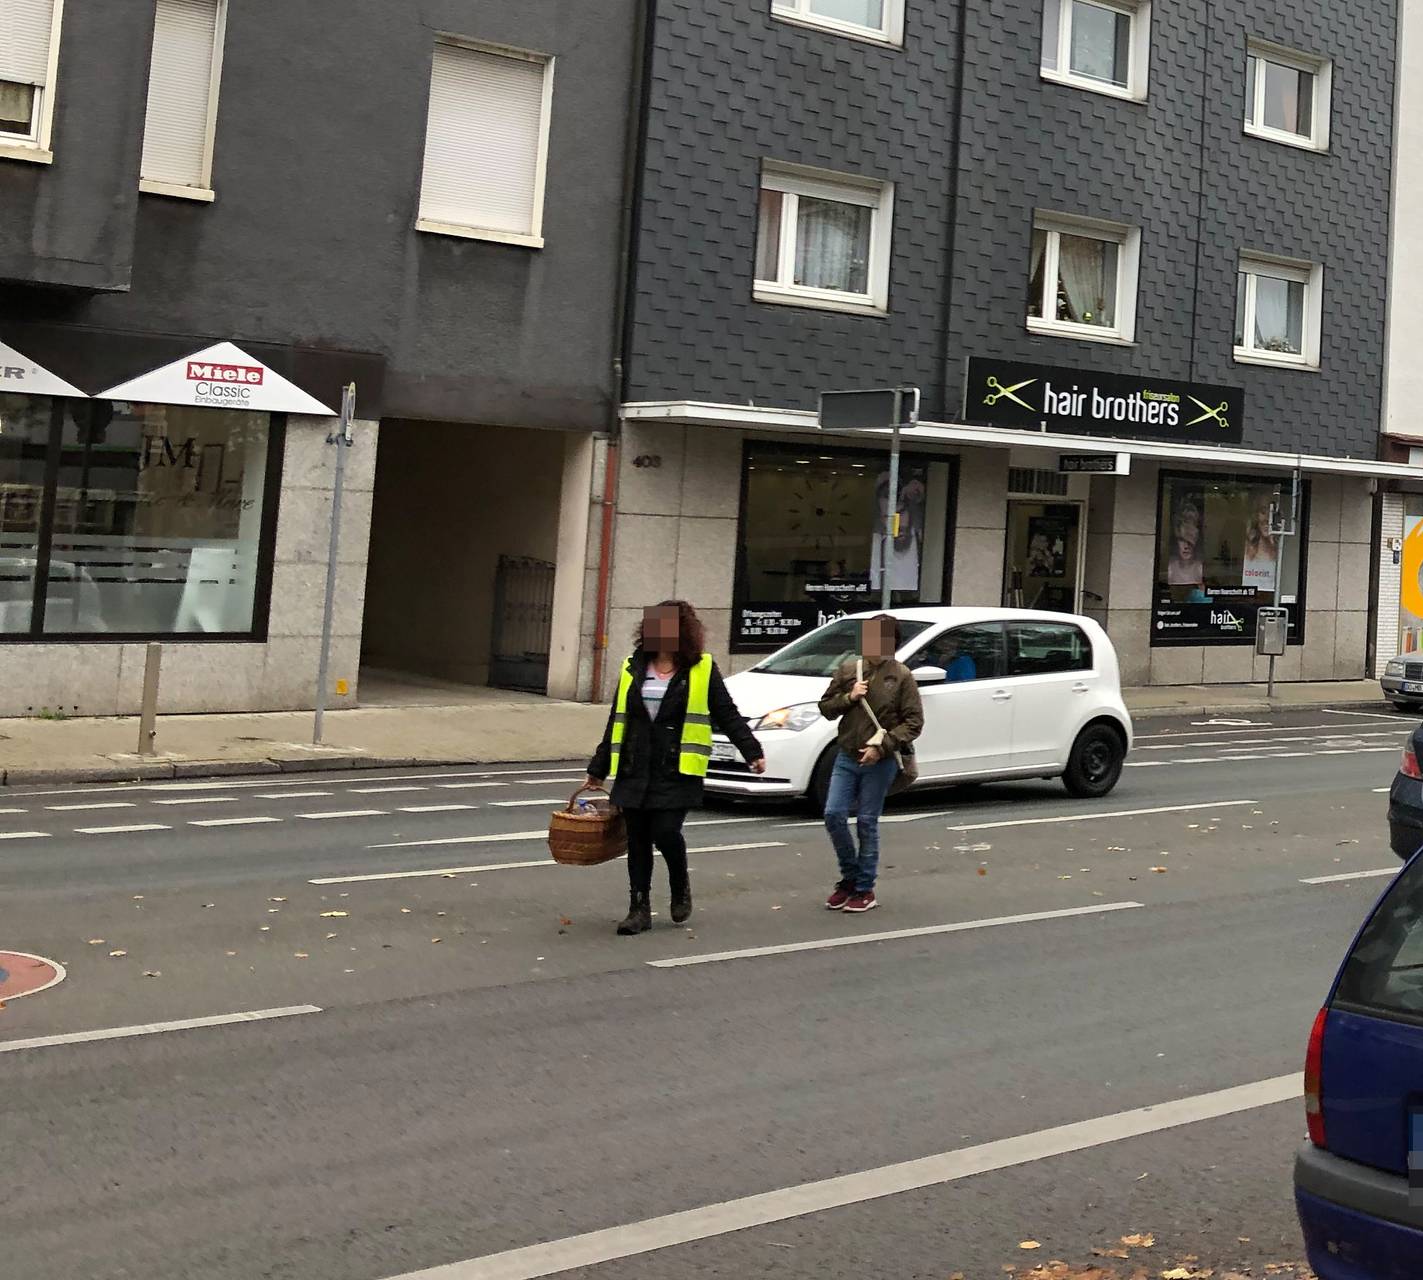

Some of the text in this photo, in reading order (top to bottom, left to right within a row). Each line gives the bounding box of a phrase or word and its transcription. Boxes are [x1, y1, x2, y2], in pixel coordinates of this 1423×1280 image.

[189, 364, 261, 383] Miele
[195, 382, 251, 399] Classic
[1043, 382, 1180, 426] hair brothers
[1210, 610, 1232, 625] hair
